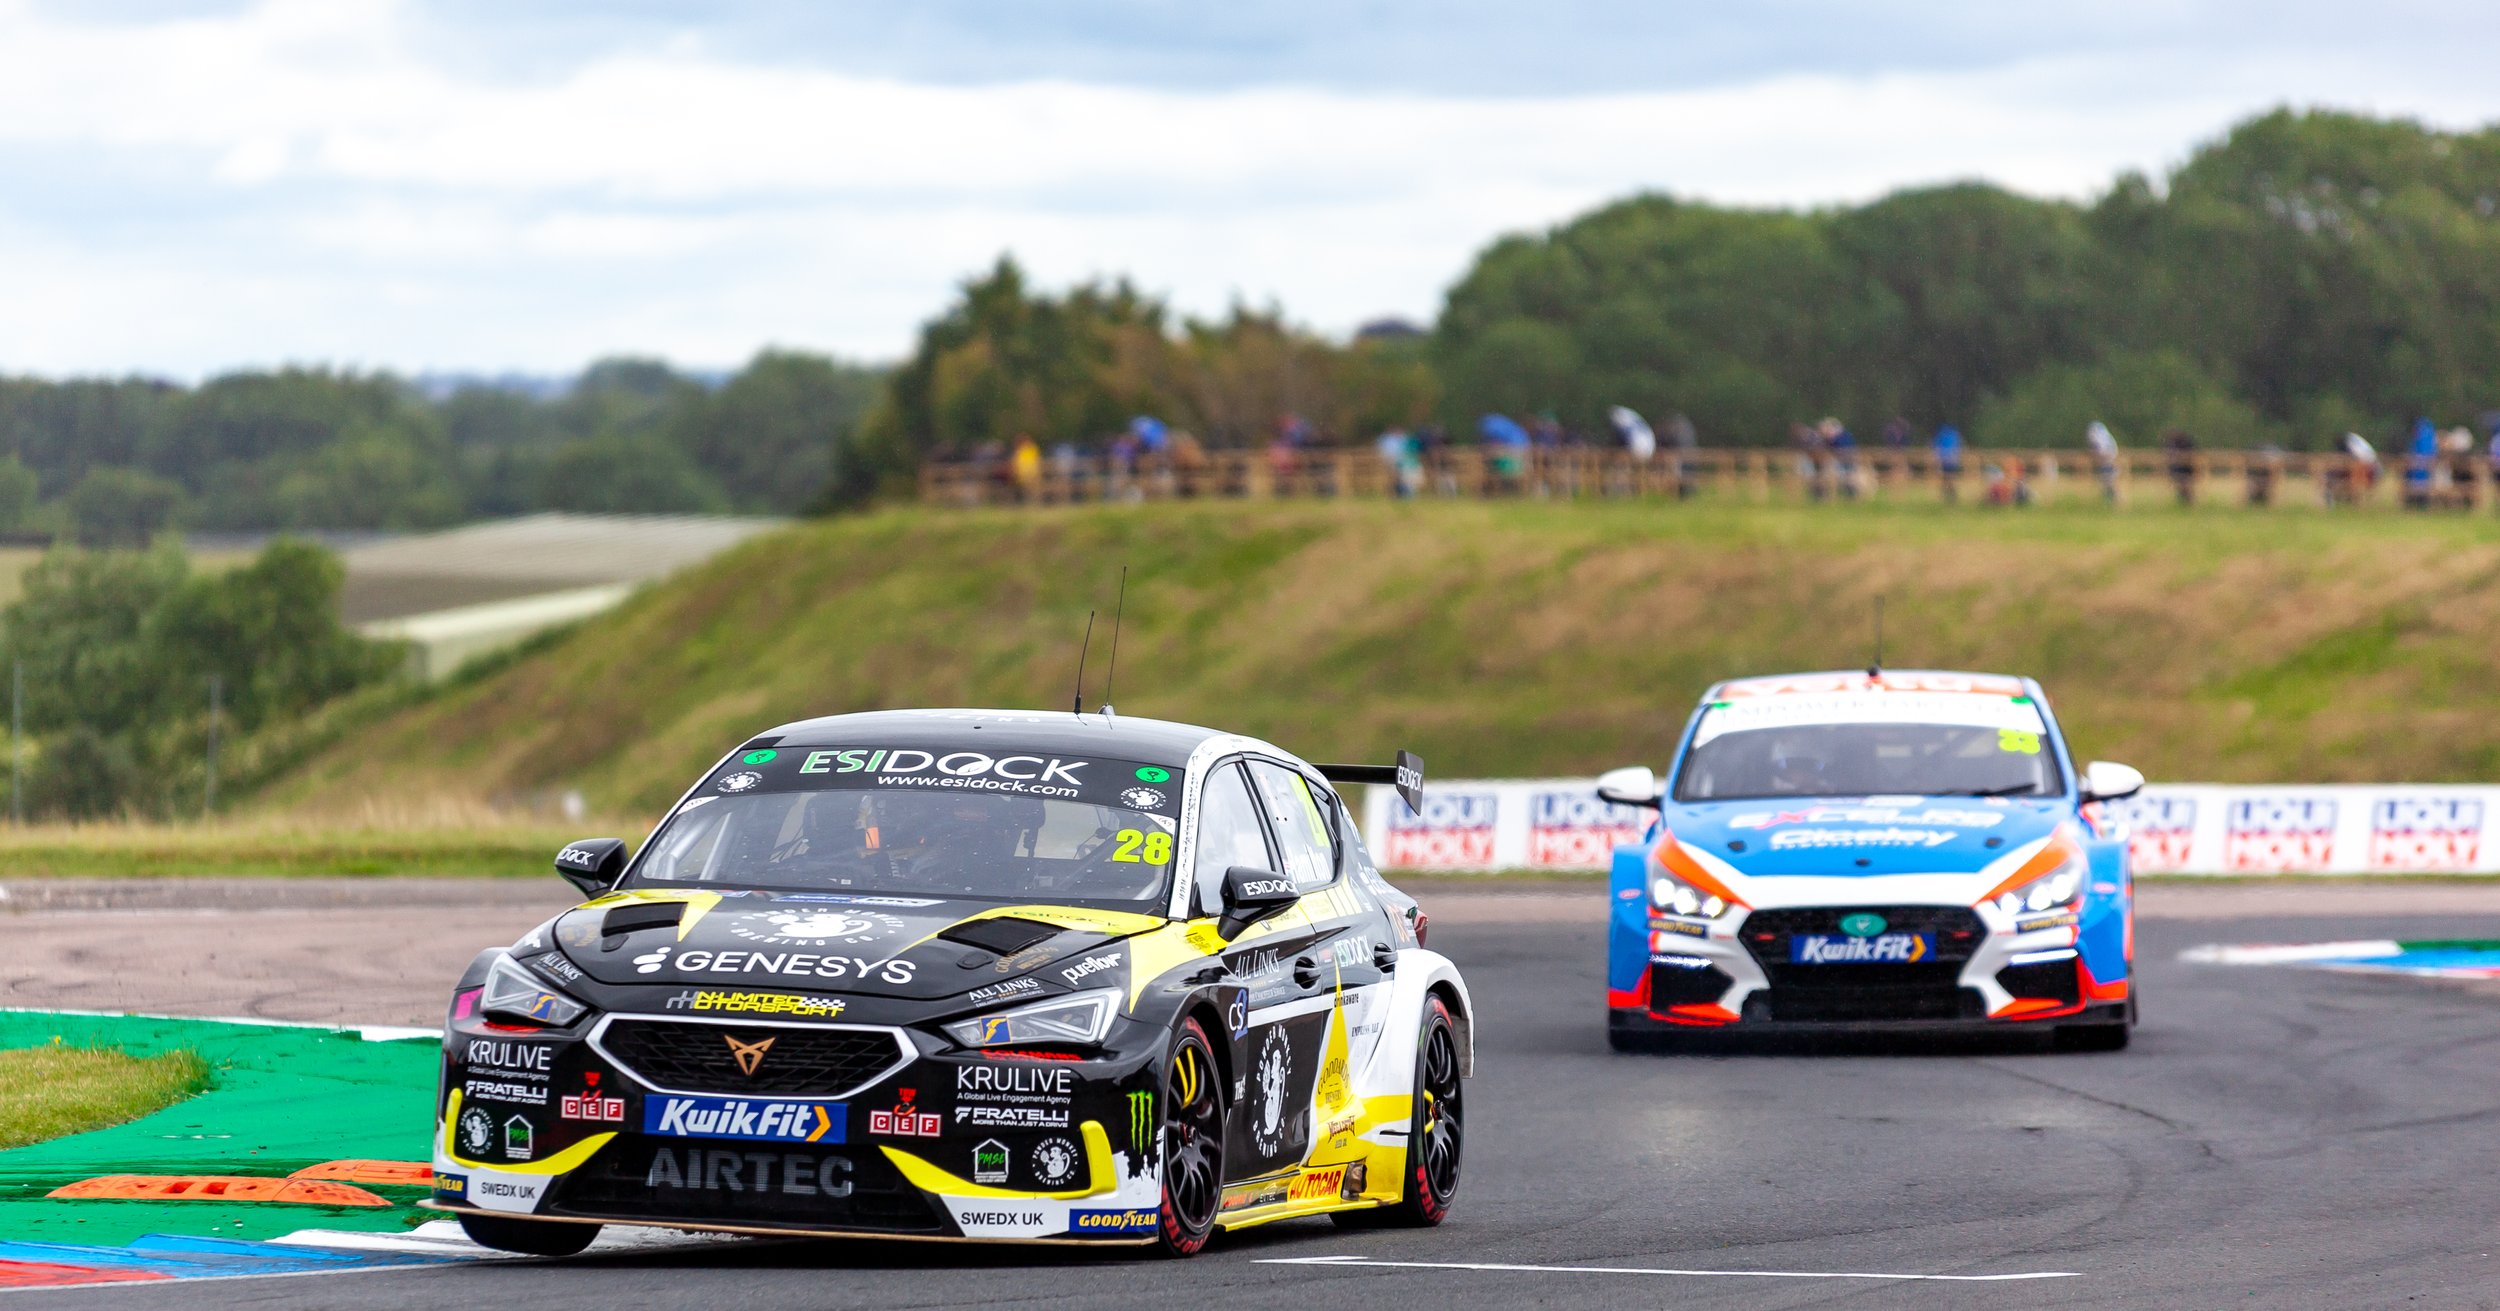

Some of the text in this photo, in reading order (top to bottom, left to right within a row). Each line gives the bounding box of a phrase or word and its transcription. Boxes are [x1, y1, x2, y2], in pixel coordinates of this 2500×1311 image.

[799, 750, 1090, 785] ESIDOCK
[1398, 765, 1423, 792] ESIDOCK
[878, 775, 1078, 798] www.esidock.com
[1112, 829, 1171, 865] 28
[1243, 880, 1299, 897] ESIDOC
[1234, 948, 1280, 980] ALL LINKS
[1334, 935, 1375, 968] ESIDOCK
[674, 951, 917, 984] GENESYS
[1061, 953, 1121, 985] pureflow
[968, 978, 1039, 1001] ALL LINKS
[467, 1040, 552, 1070] KRULIVE
[1256, 1025, 1277, 1083] POWDER
[476, 1082, 548, 1098] FRATELLI
[957, 1066, 1071, 1093] KRULIVE
[987, 1093, 1001, 1101] Live
[1002, 1094, 1045, 1103] Engagement
[1046, 1096, 1071, 1105] Agency
[973, 1107, 1069, 1121] FRATELLI
[645, 1148, 853, 1197] AIRTEC
[977, 1153, 1005, 1167] PMSE
[481, 1182, 536, 1199] SWEDX UK
[1290, 1170, 1341, 1199] AUTOCAR
[961, 1212, 1044, 1225] SWEDX UK
[1079, 1210, 1157, 1230] GOODYEAR
